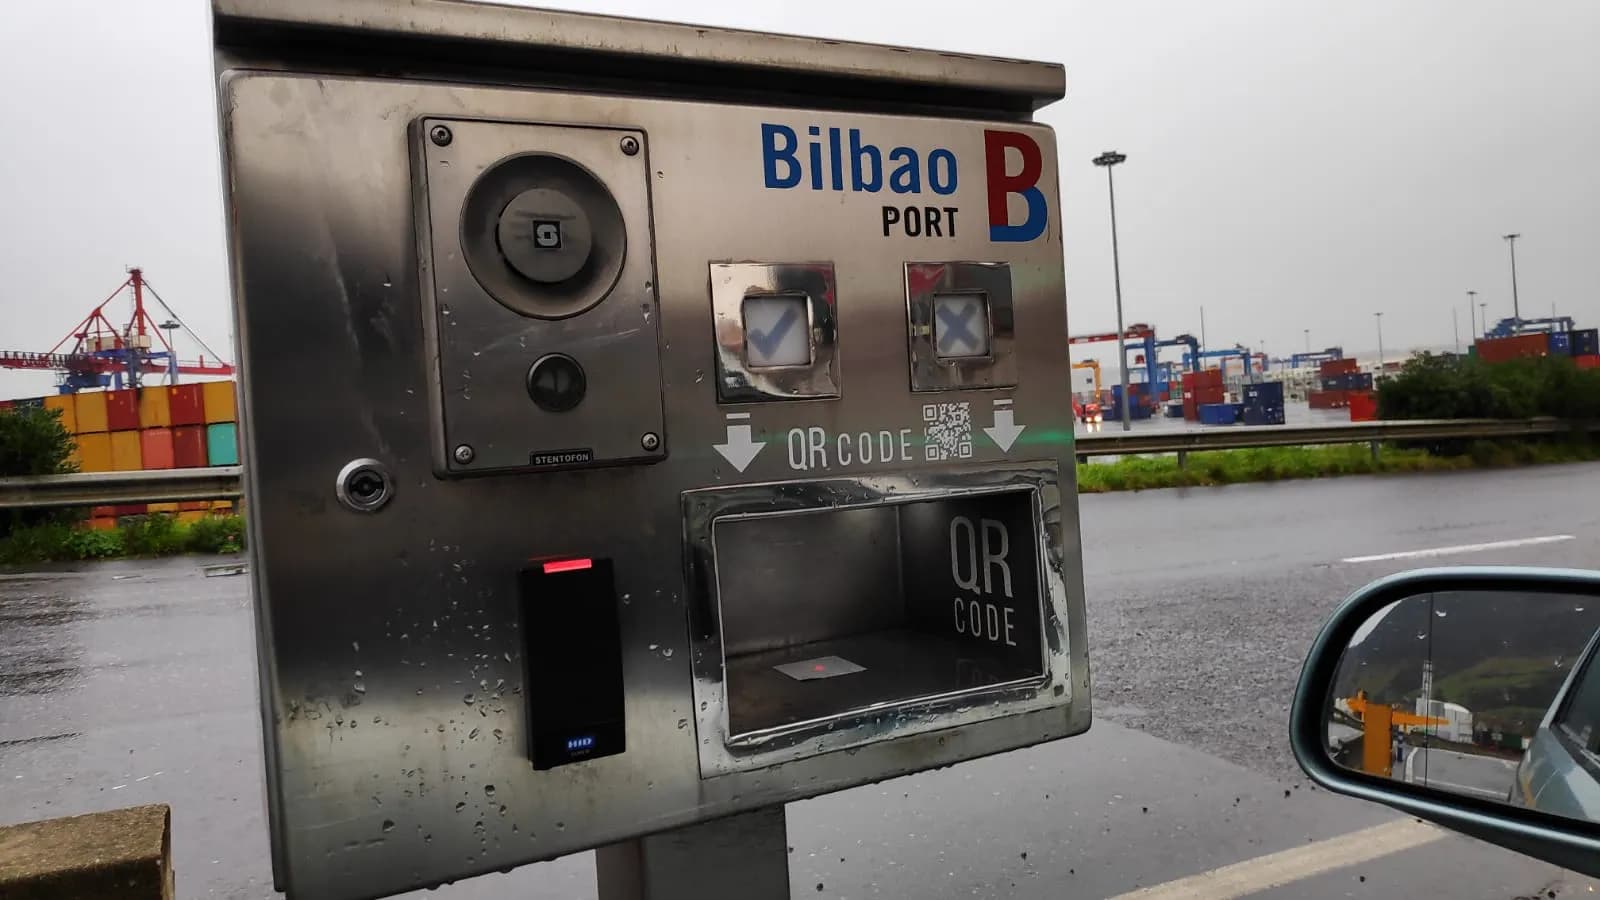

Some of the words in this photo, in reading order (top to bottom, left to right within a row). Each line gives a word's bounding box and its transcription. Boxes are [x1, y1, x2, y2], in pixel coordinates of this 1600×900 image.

[761, 123, 958, 195] Bilbao
[984, 129, 1048, 242] B
[882, 206, 958, 238] PORT
[534, 453, 590, 465] STENTOFON
[787, 426, 828, 471] QR
[837, 429, 913, 466] CODE
[950, 515, 1013, 598] QR
[954, 597, 1017, 647] CODE
[567, 737, 593, 749] HID
